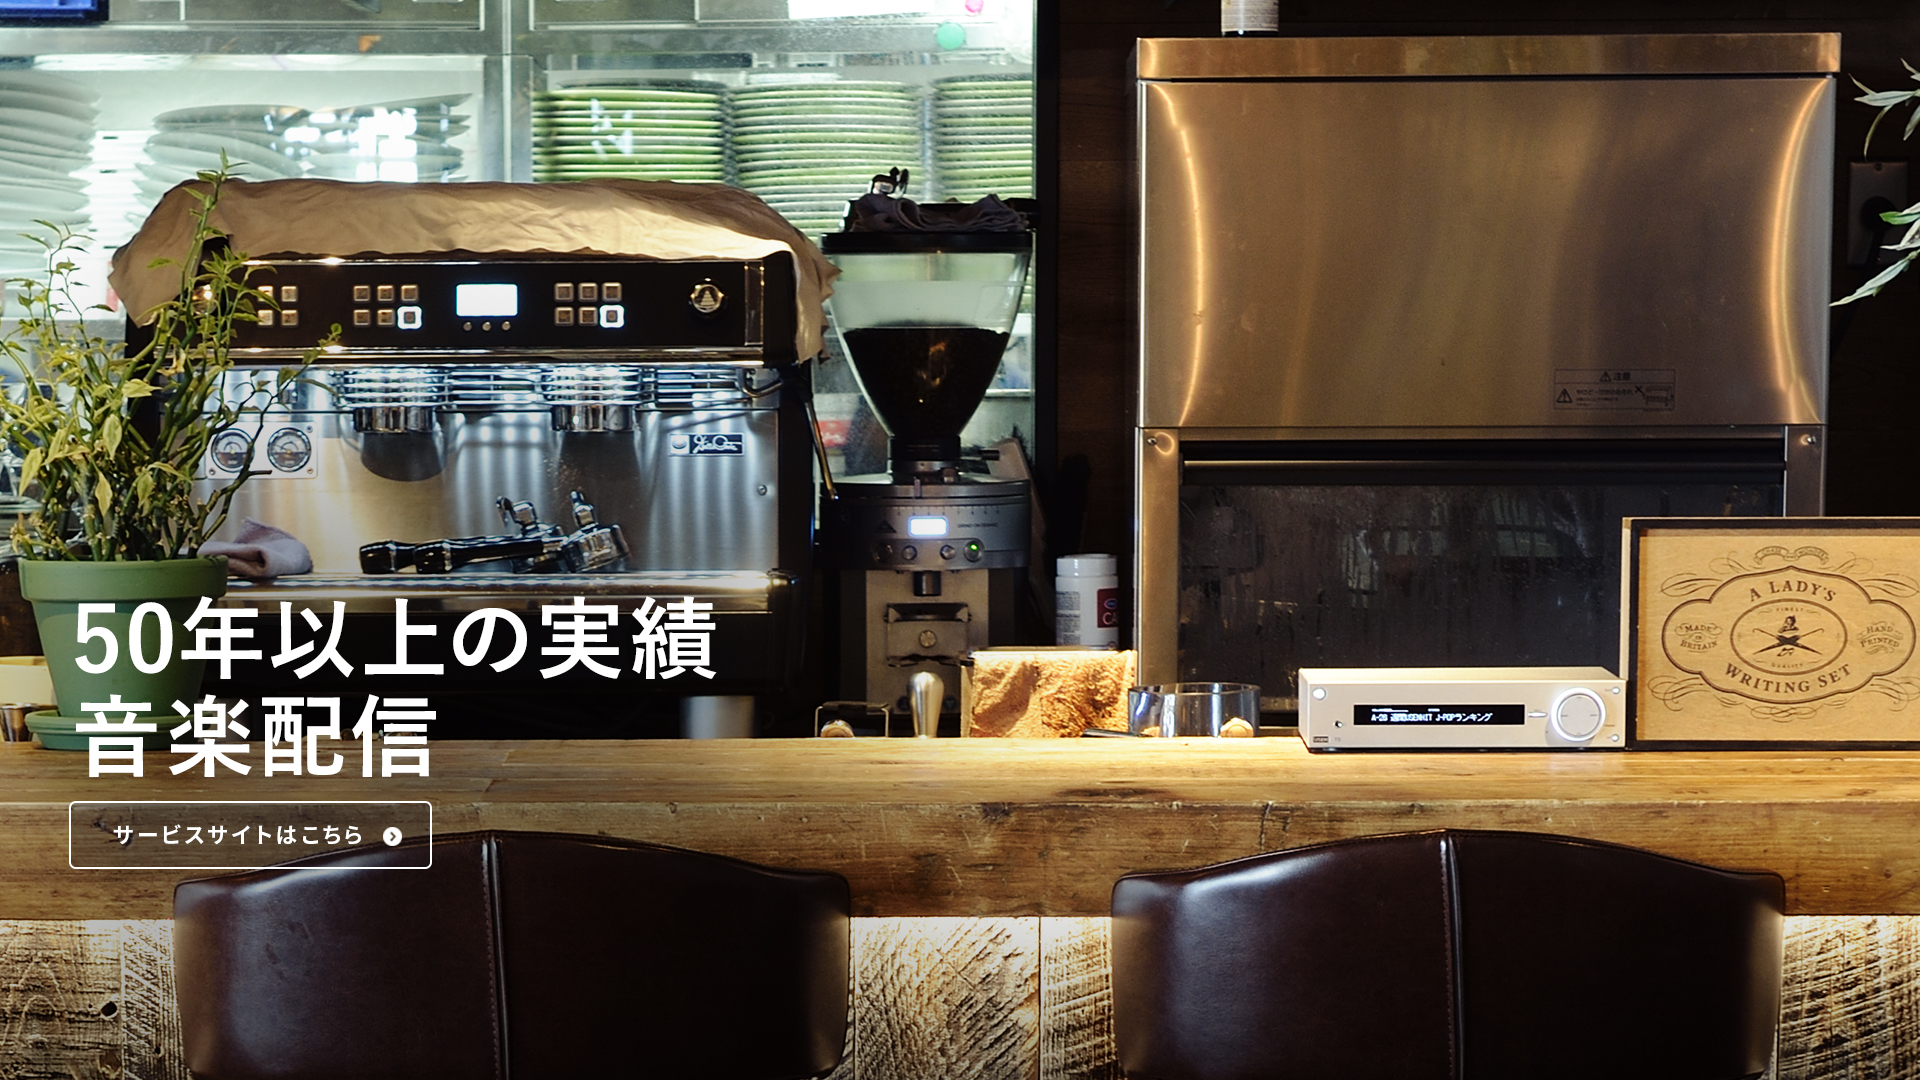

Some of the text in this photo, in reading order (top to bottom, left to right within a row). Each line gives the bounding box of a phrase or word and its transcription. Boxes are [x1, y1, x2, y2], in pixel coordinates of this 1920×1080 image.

[1750, 580, 1836, 602] A LADY'S
[1685, 624, 1712, 632] MADE
[1867, 625, 1893, 634] HAND
[1680, 639, 1717, 650] BRITAIN
[1860, 637, 1900, 648] PRINTED
[1725, 662, 1851, 693] WRITING SET
